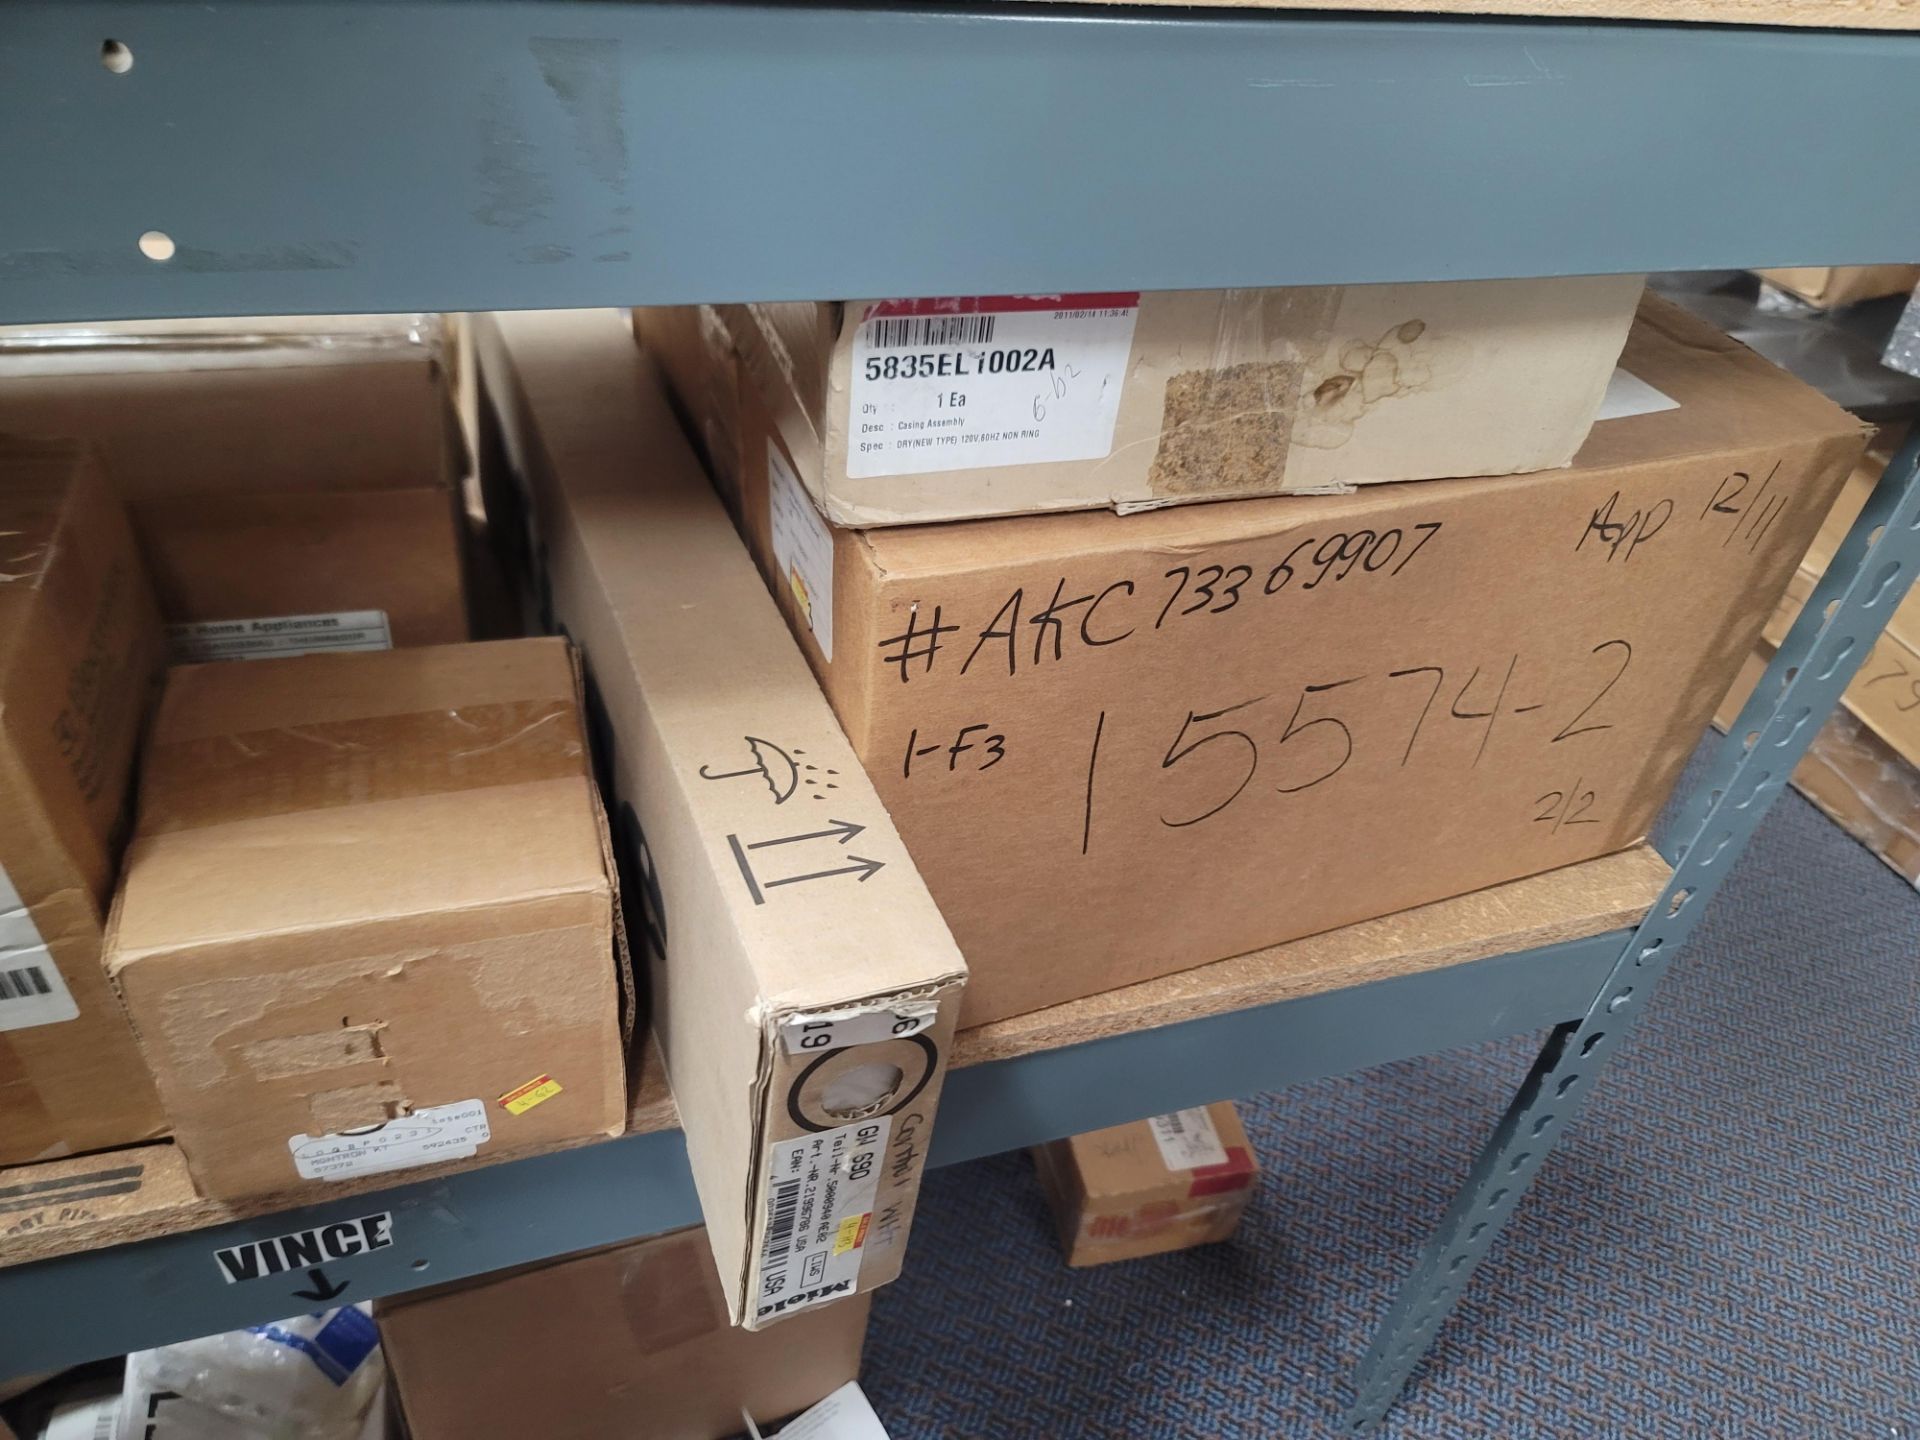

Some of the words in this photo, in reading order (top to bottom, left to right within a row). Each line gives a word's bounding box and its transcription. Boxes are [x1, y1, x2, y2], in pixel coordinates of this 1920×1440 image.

[950, 392, 966, 407] Ea
[862, 423, 884, 433] Desc
[898, 420, 924, 430] Casing
[927, 417, 965, 428] Assembly
[860, 442, 883, 453] Spec
[1002, 431, 1019, 440] NON
[1021, 429, 1039, 439] RING
[252, 618, 339, 633] Appliances
[1534, 776, 1600, 835] 2/2
[216, 1213, 392, 1282] VINCE
[763, 1269, 786, 1297] USA
[757, 1279, 851, 1317] Miele
